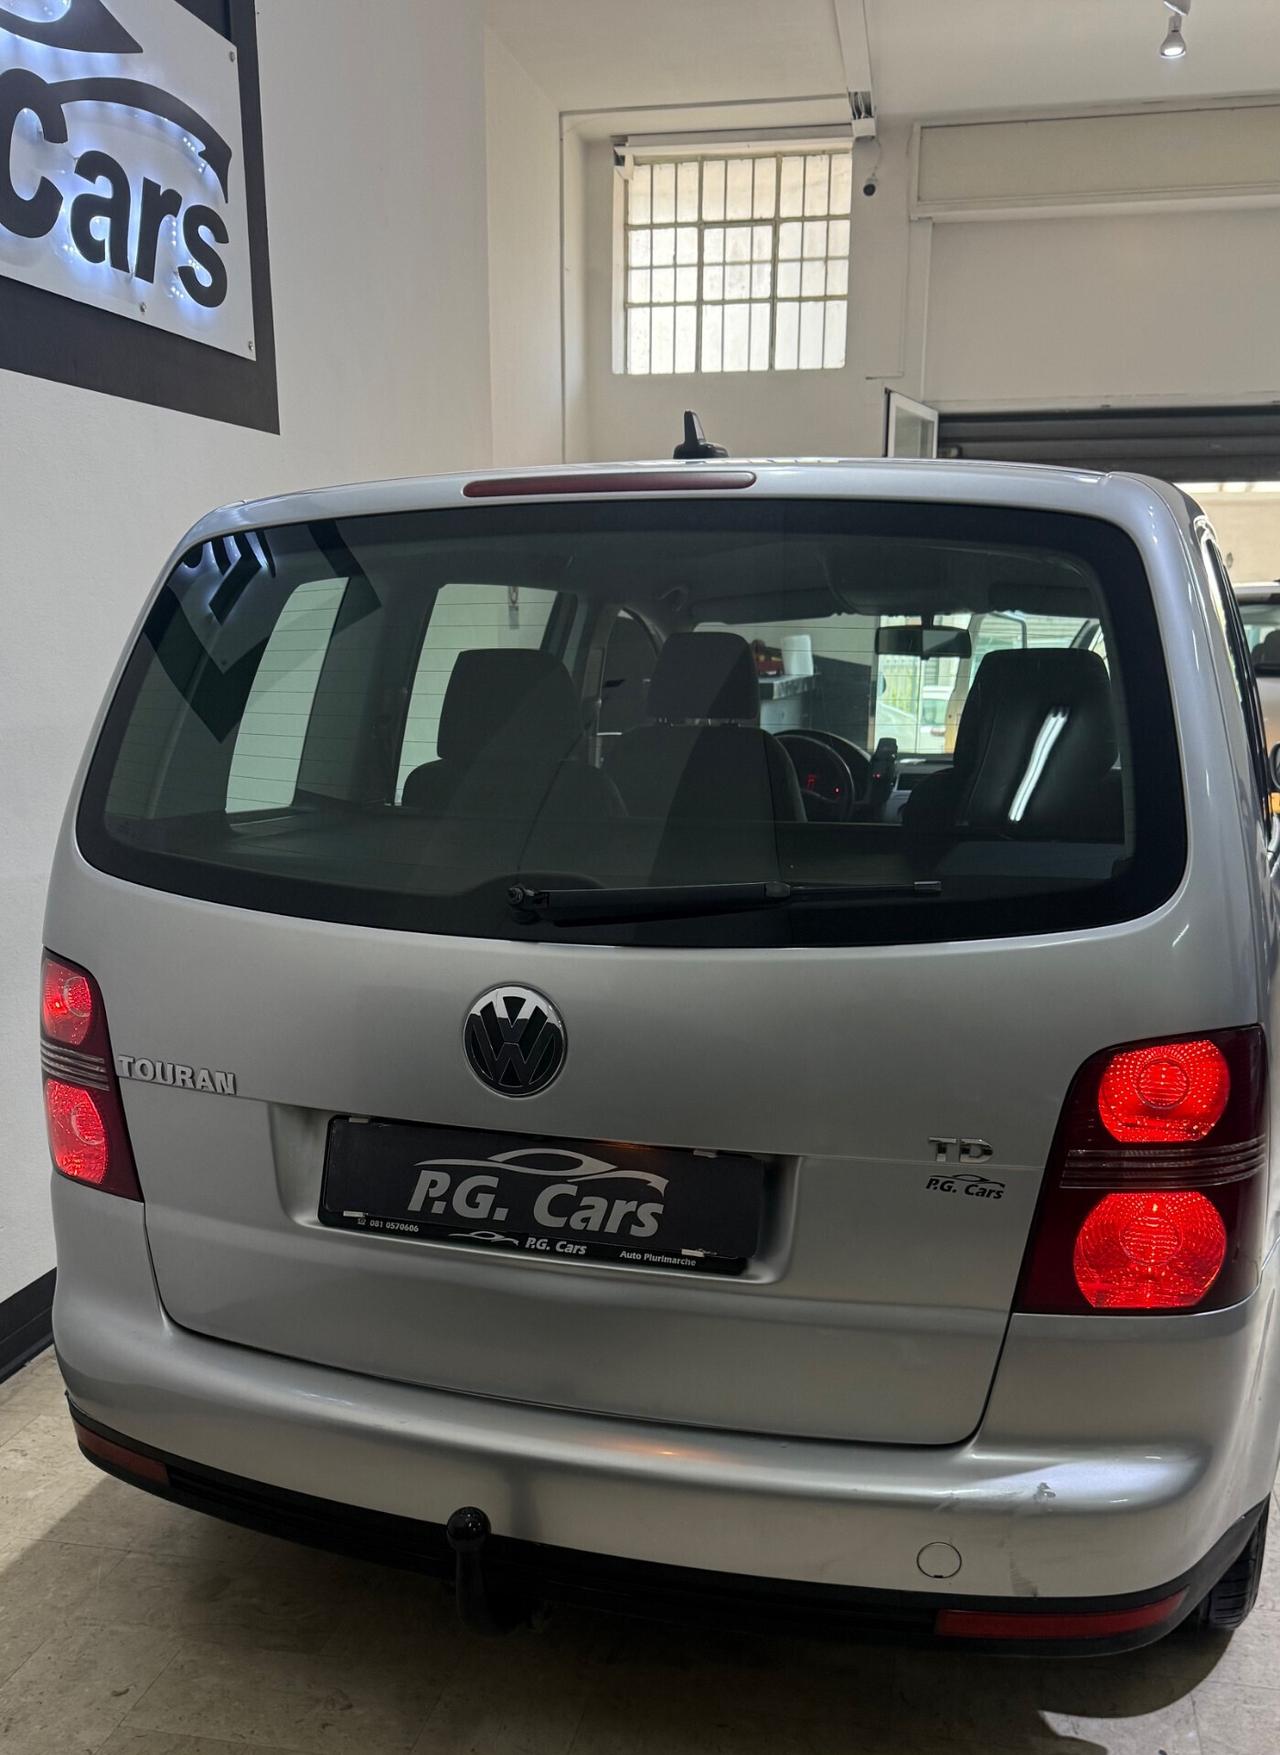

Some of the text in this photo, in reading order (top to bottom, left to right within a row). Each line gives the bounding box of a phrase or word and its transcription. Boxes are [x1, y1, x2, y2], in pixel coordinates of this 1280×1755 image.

[464, 985, 565, 1097] VW
[117, 1054, 237, 1095] TOURAN
[928, 1137, 993, 1164] TD
[926, 1178, 1004, 1200] P.G. Cars
[407, 1169, 665, 1238] P.G. Cars
[369, 1219, 383, 1228] 081
[525, 1237, 587, 1255] P.G. Cars
[619, 1250, 697, 1267] Auto Plurimarche
